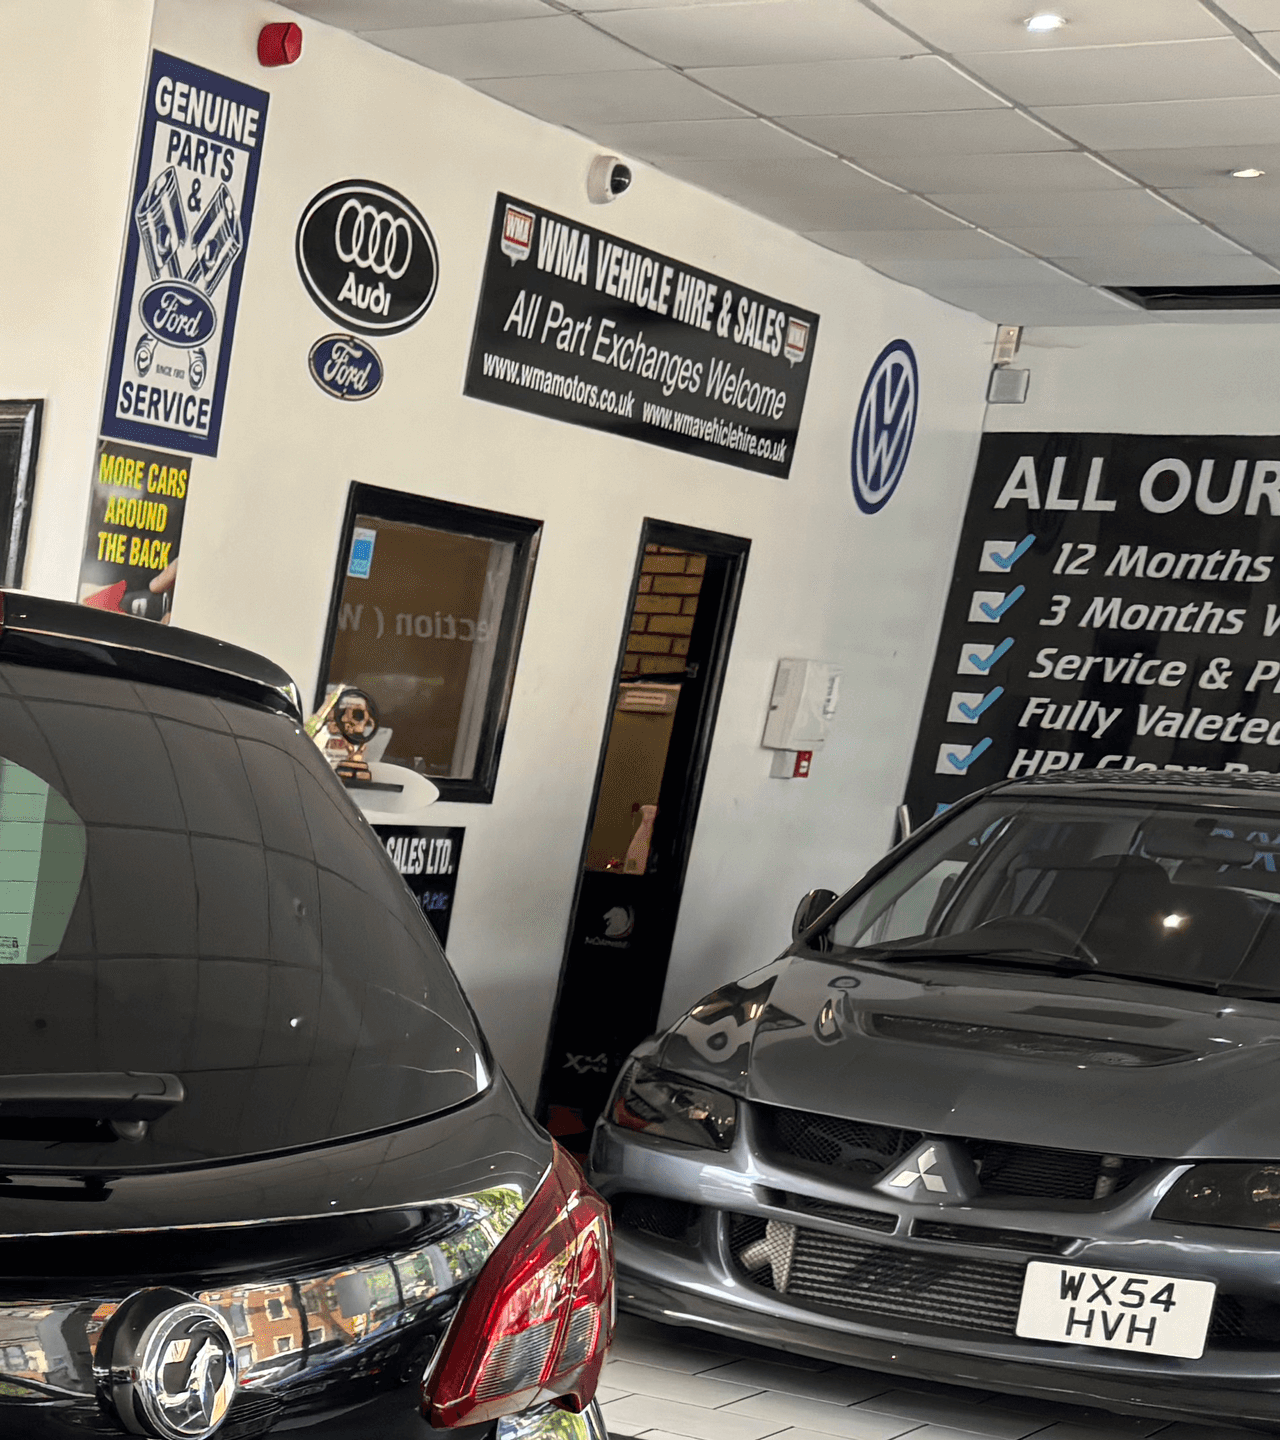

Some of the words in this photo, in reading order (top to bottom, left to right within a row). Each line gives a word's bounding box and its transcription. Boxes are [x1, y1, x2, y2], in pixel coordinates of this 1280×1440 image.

[155, 75, 260, 148] GENUINE
[166, 129, 235, 182] PARTS
[187, 178, 202, 213] &
[337, 271, 391, 317] Audi
[537, 216, 591, 286] WMA
[594, 239, 674, 315] VEHICLE
[672, 272, 718, 333] HIRE
[716, 290, 735, 338] &
[733, 296, 786, 358] SALES
[153, 290, 203, 338] Ford
[323, 341, 372, 392] Ford
[503, 289, 542, 340] All
[540, 300, 592, 356] Part
[592, 317, 704, 397] Exchanges
[704, 356, 788, 421] Welcome
[119, 380, 211, 431] SERVICE
[483, 351, 636, 419] www.wmamotors.co.uk
[641, 399, 788, 464] www.wmavehiclehire.co.uk
[98, 452, 145, 490] MORE
[147, 463, 188, 499] CARS
[994, 455, 1118, 512] ALL
[104, 495, 169, 533] AROUND
[97, 531, 127, 565] THE
[129, 536, 172, 571] BACK
[1051, 542, 1097, 577] 12
[1104, 544, 1275, 584] Months
[1039, 594, 1068, 628] 3
[1078, 595, 1246, 638] Months
[1028, 647, 1187, 687] Service
[1199, 658, 1233, 690] &
[1017, 696, 1123, 740] Fully
[386, 836, 426, 875] SALES
[425, 838, 453, 875] LTD.
[1060, 1269, 1176, 1312] WX54
[1065, 1306, 1157, 1346] HVH
